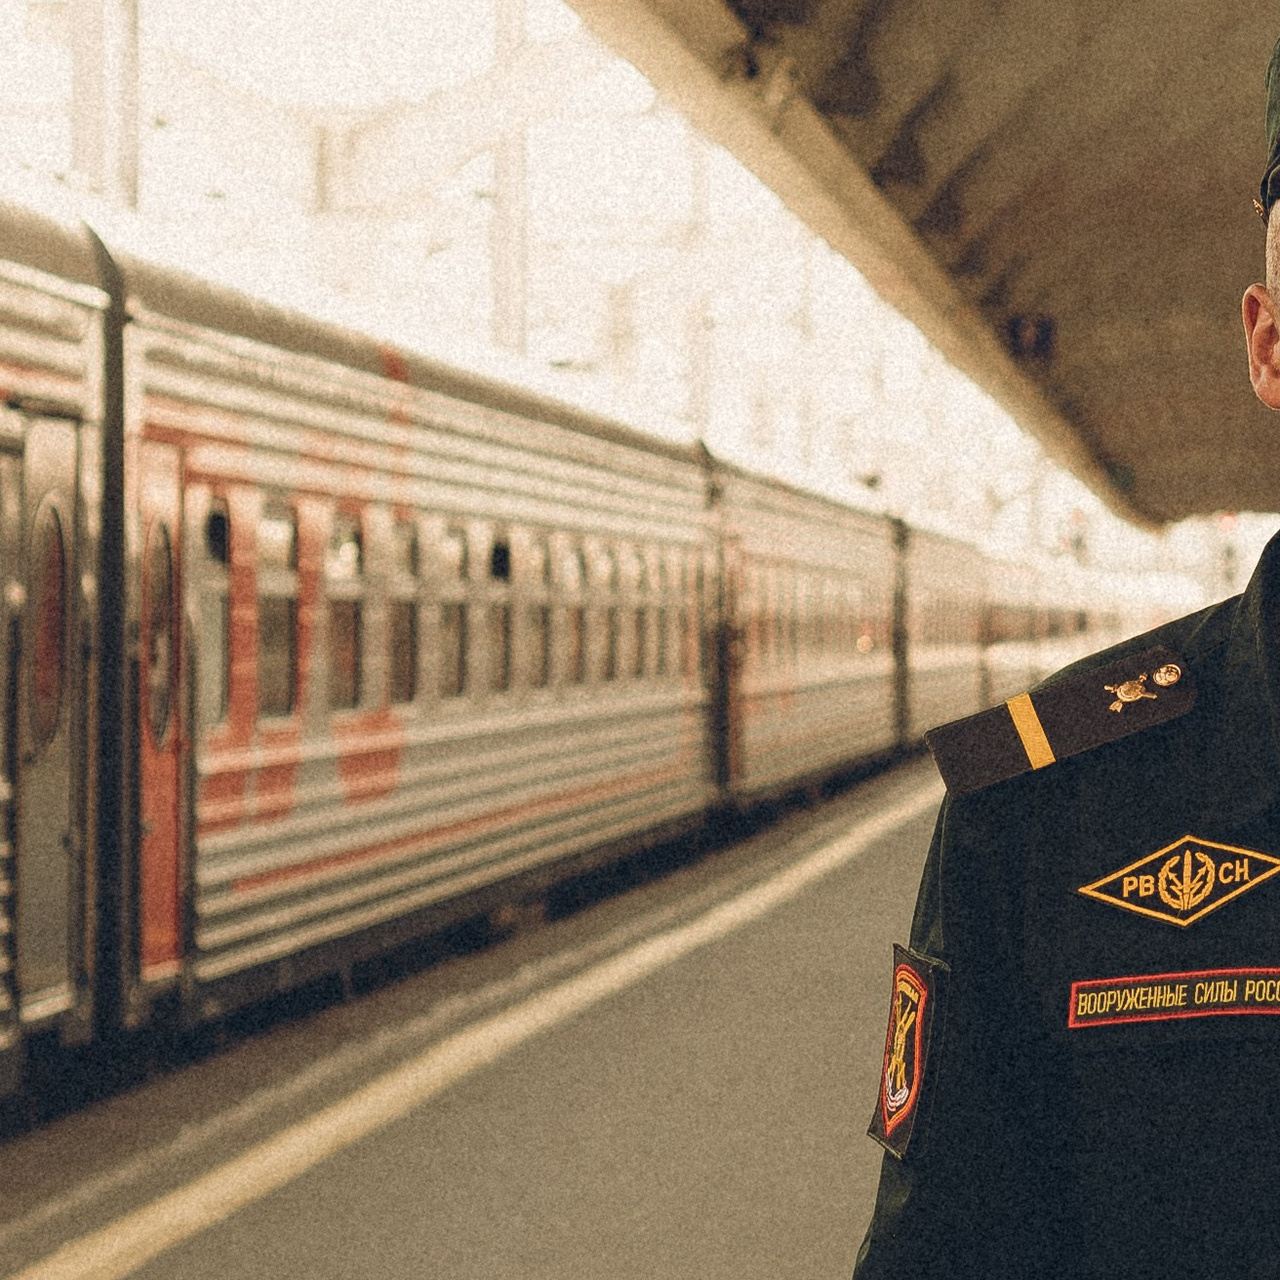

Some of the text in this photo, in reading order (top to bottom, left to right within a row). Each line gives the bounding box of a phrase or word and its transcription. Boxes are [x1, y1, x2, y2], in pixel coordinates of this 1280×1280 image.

[1123, 858, 1250, 898] РВ СН
[1077, 984, 1188, 1016] ВООРУЖЕННЫЕ
[1194, 980, 1237, 1005] СИЛЫ
